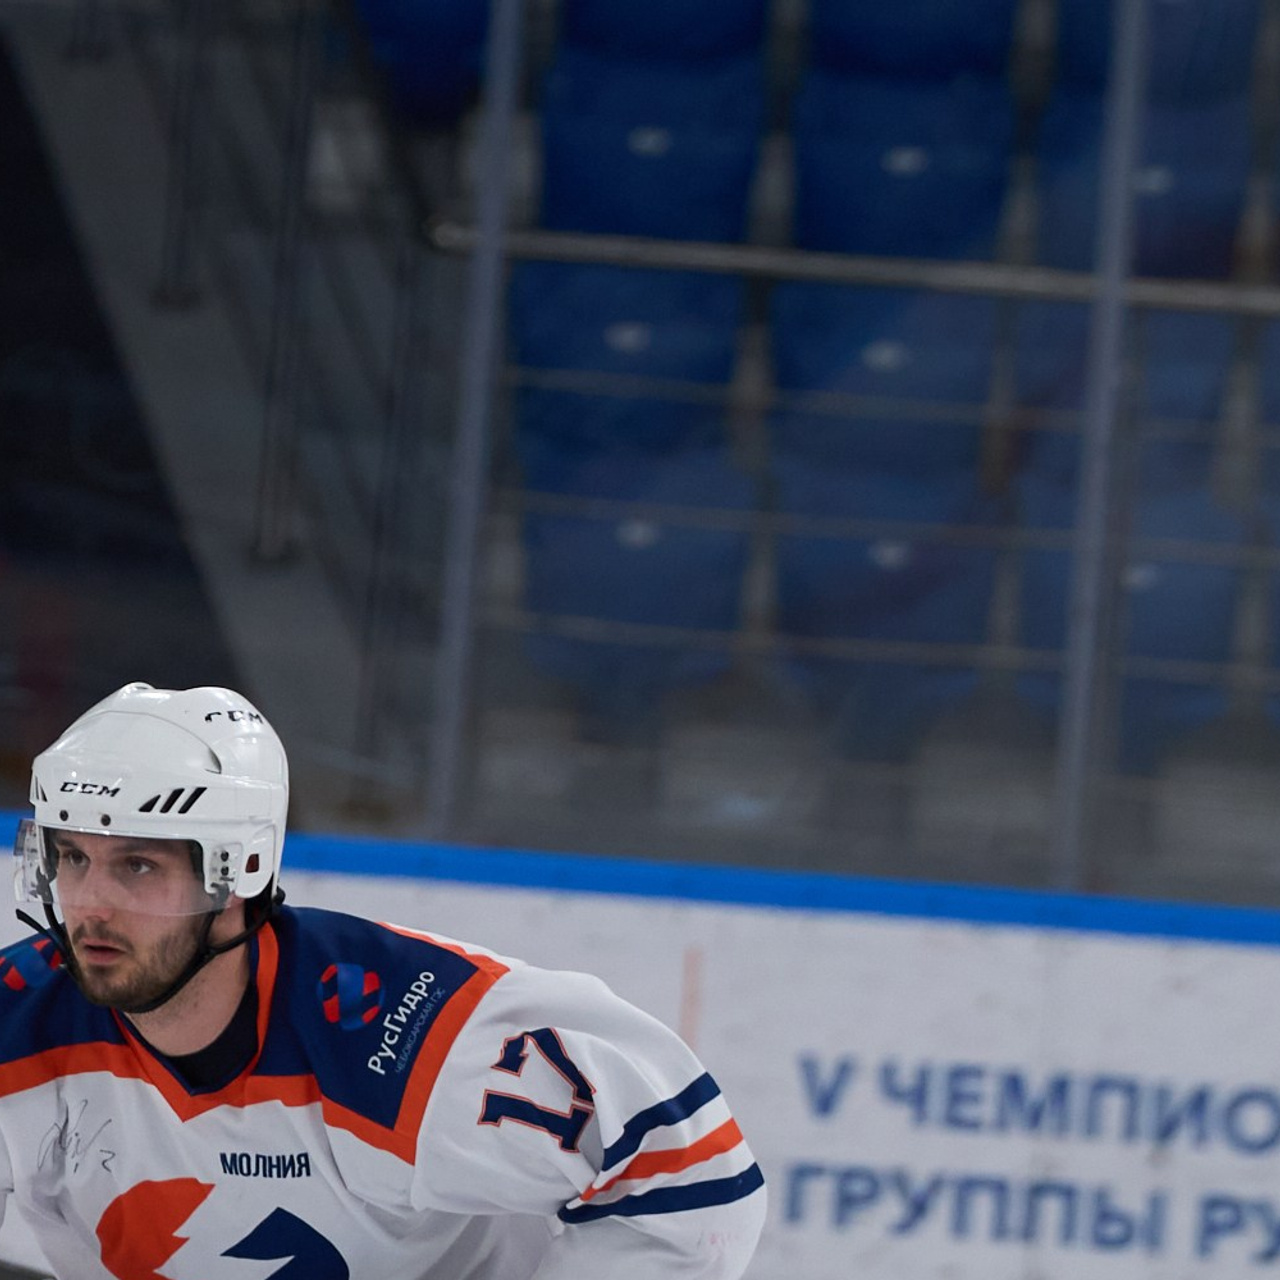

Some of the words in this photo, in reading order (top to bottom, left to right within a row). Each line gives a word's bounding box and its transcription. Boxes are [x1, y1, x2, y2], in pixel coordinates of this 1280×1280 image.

[59, 780, 121, 799] CCM
[368, 971, 435, 1075] РусГидро
[477, 1027, 596, 1154] 17
[797, 1052, 855, 1118] V
[878, 1054, 1280, 1154] ЧЕМПИО
[220, 1152, 311, 1179] МОЛНИЯ
[783, 1162, 1169, 1256] ГРУППЫ
